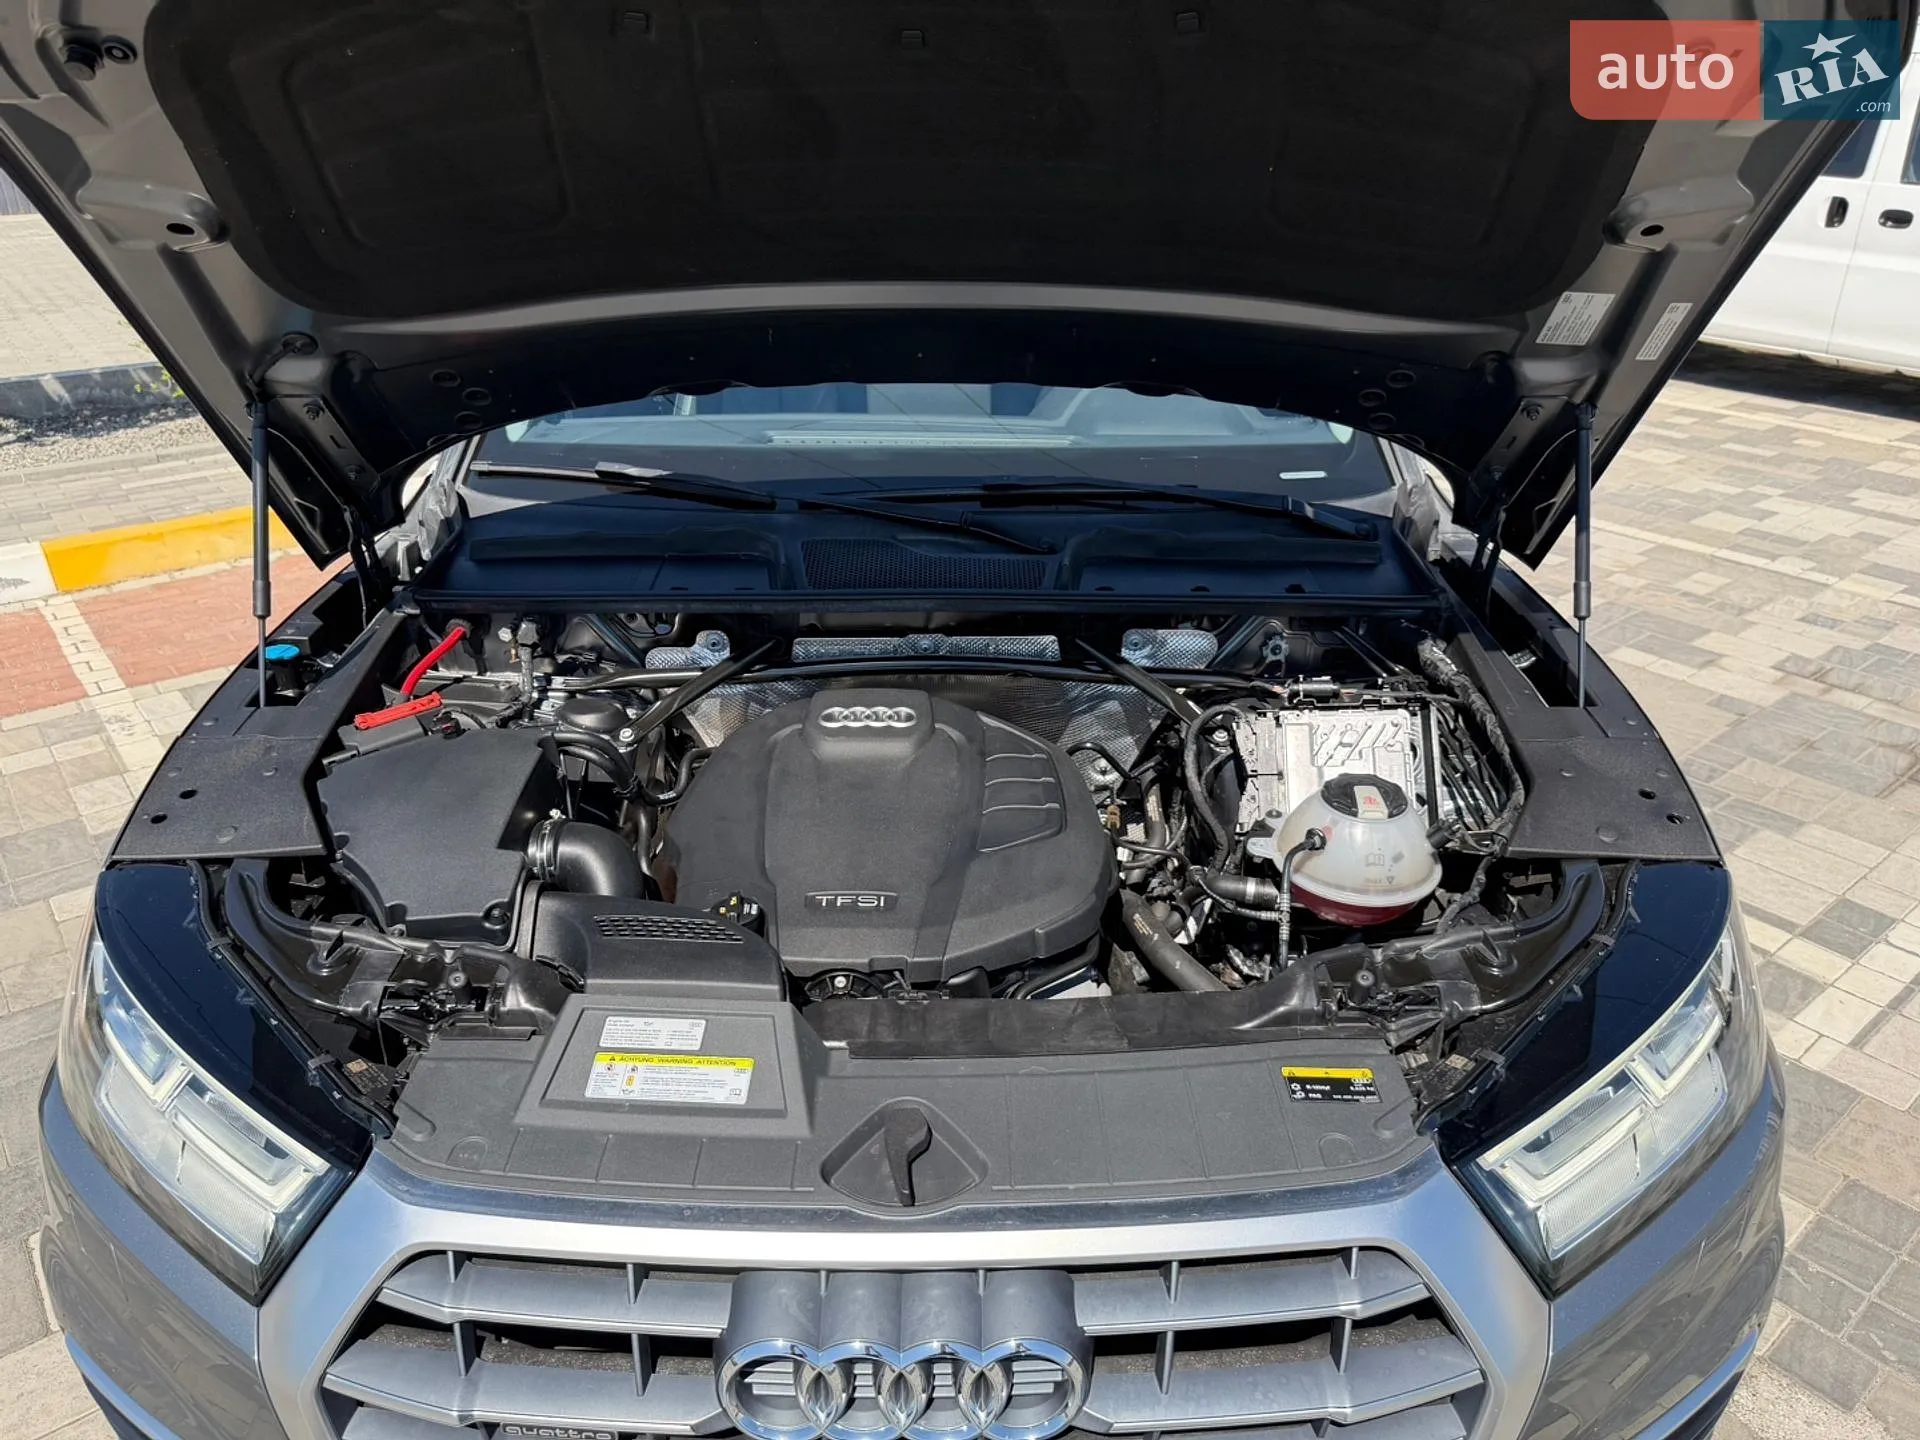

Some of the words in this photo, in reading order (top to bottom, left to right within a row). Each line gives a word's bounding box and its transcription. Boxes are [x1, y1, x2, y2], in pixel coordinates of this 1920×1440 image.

[815, 895, 885, 907] TFSI
[618, 1055, 654, 1063] ACHTUNG
[657, 1056, 693, 1065] WARNING
[696, 1058, 736, 1067] ATTENTION
[504, 1425, 612, 1440] quattro
